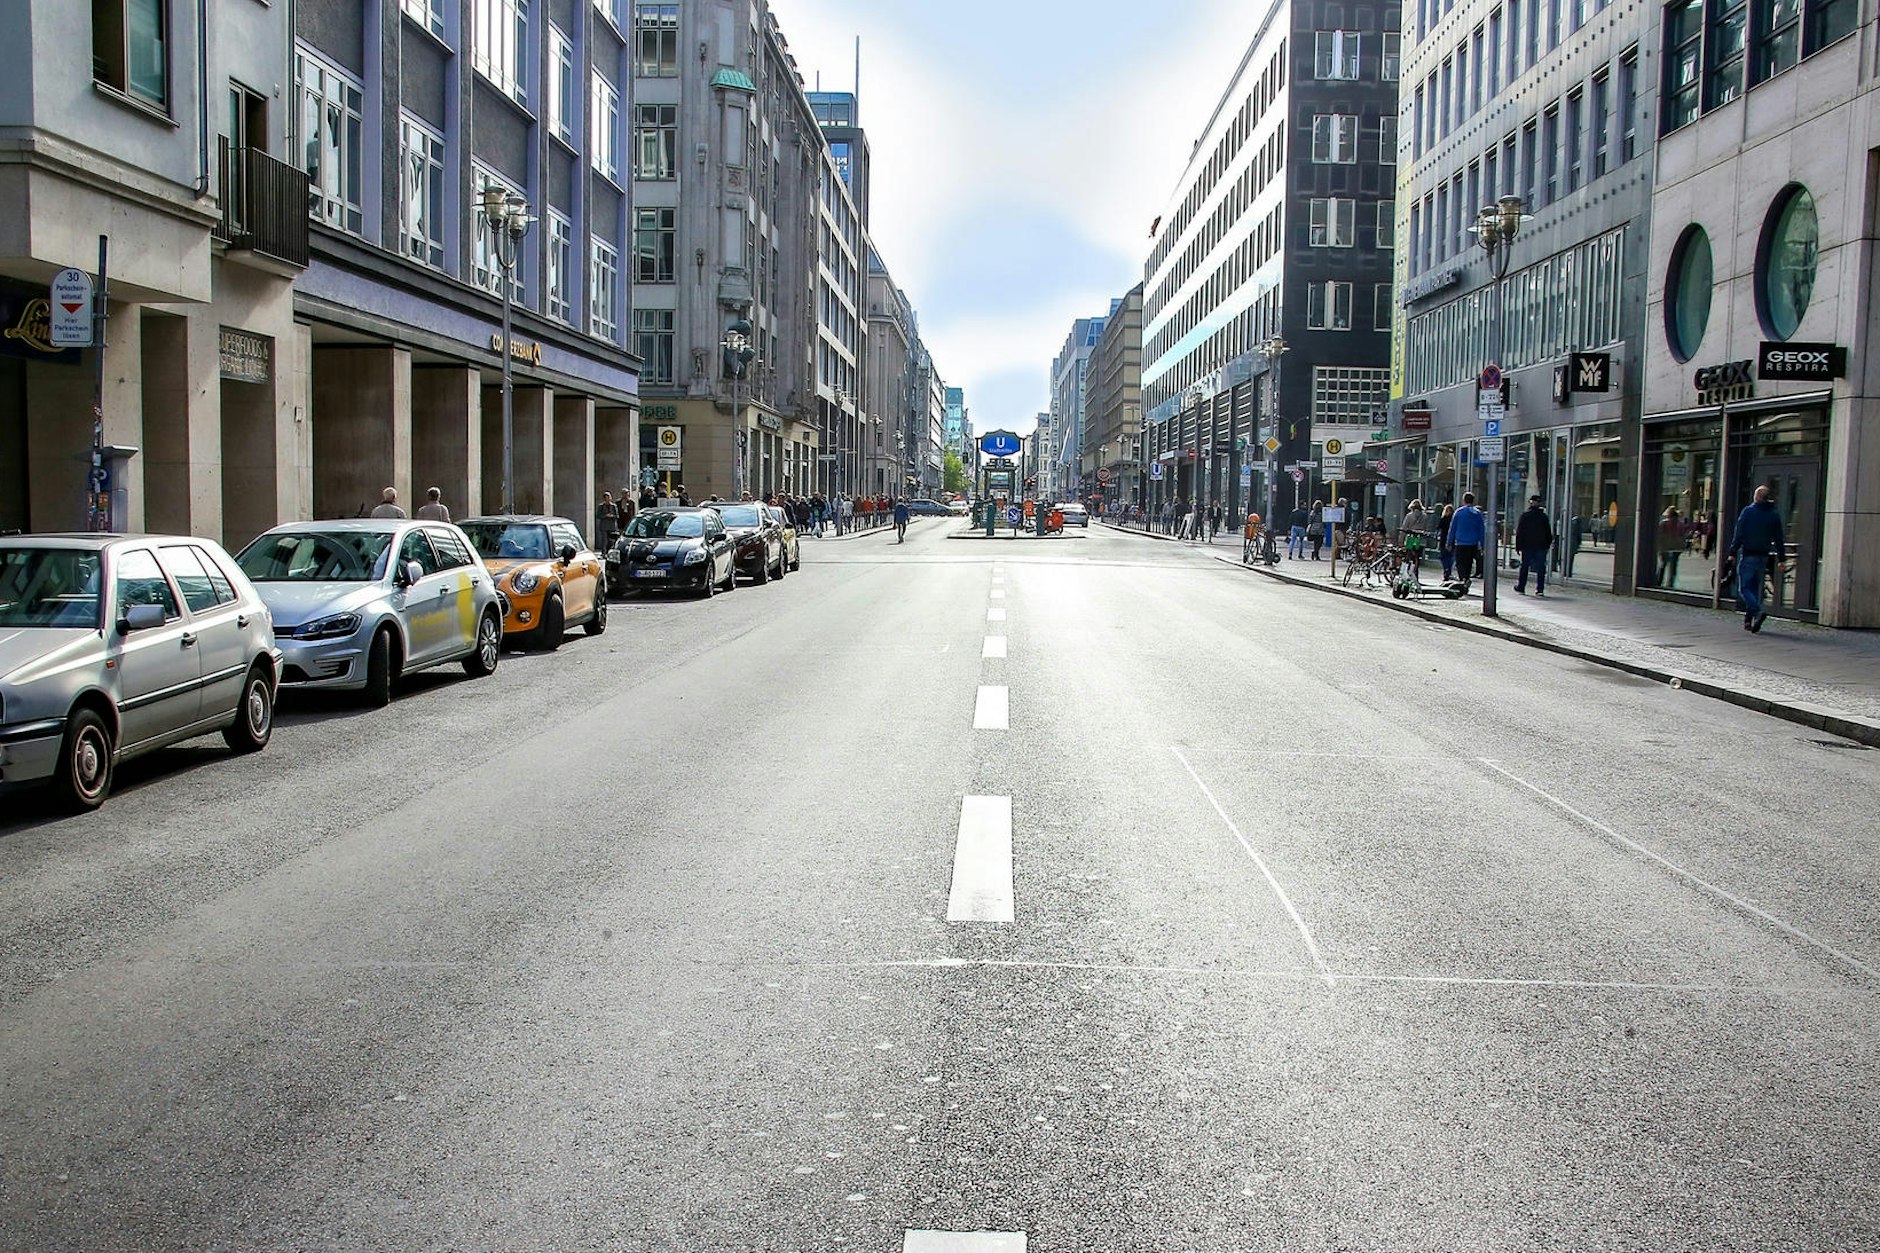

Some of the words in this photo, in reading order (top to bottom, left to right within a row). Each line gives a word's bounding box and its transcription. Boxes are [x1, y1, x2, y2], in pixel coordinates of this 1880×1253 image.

[67, 272, 79, 282] 30
[1767, 350, 1829, 363] GEOX
[1766, 362, 1829, 372] RESPIRA
[1695, 359, 1754, 391] GEOX
[1698, 382, 1754, 405] RESPIRA
[996, 436, 1006, 449] U
[1151, 463, 1162, 475] U
